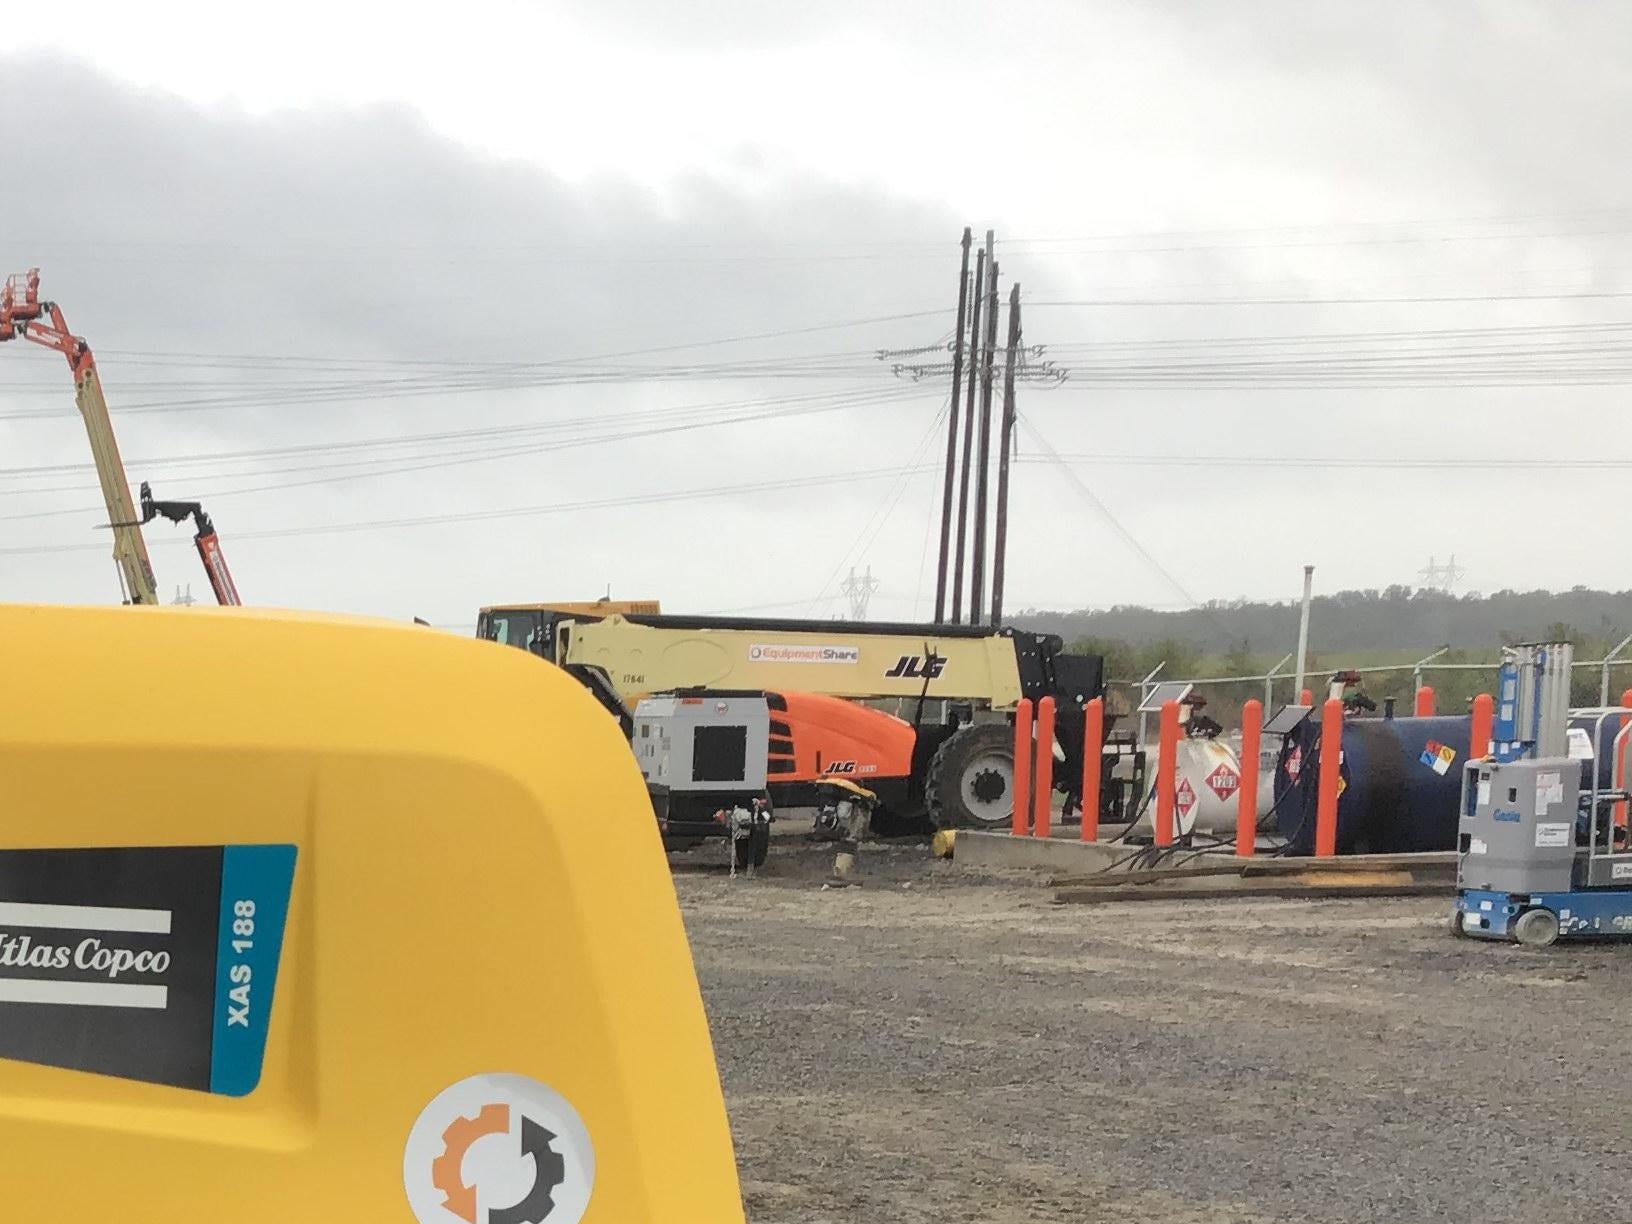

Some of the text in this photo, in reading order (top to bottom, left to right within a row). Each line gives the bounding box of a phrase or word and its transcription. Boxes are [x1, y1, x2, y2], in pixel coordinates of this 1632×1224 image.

[763, 647, 858, 660] EquipmentShare
[885, 655, 948, 679] JLG
[824, 761, 856, 774] JLG
[73, 937, 171, 978] Copco
[227, 899, 256, 1028] XAS 188
